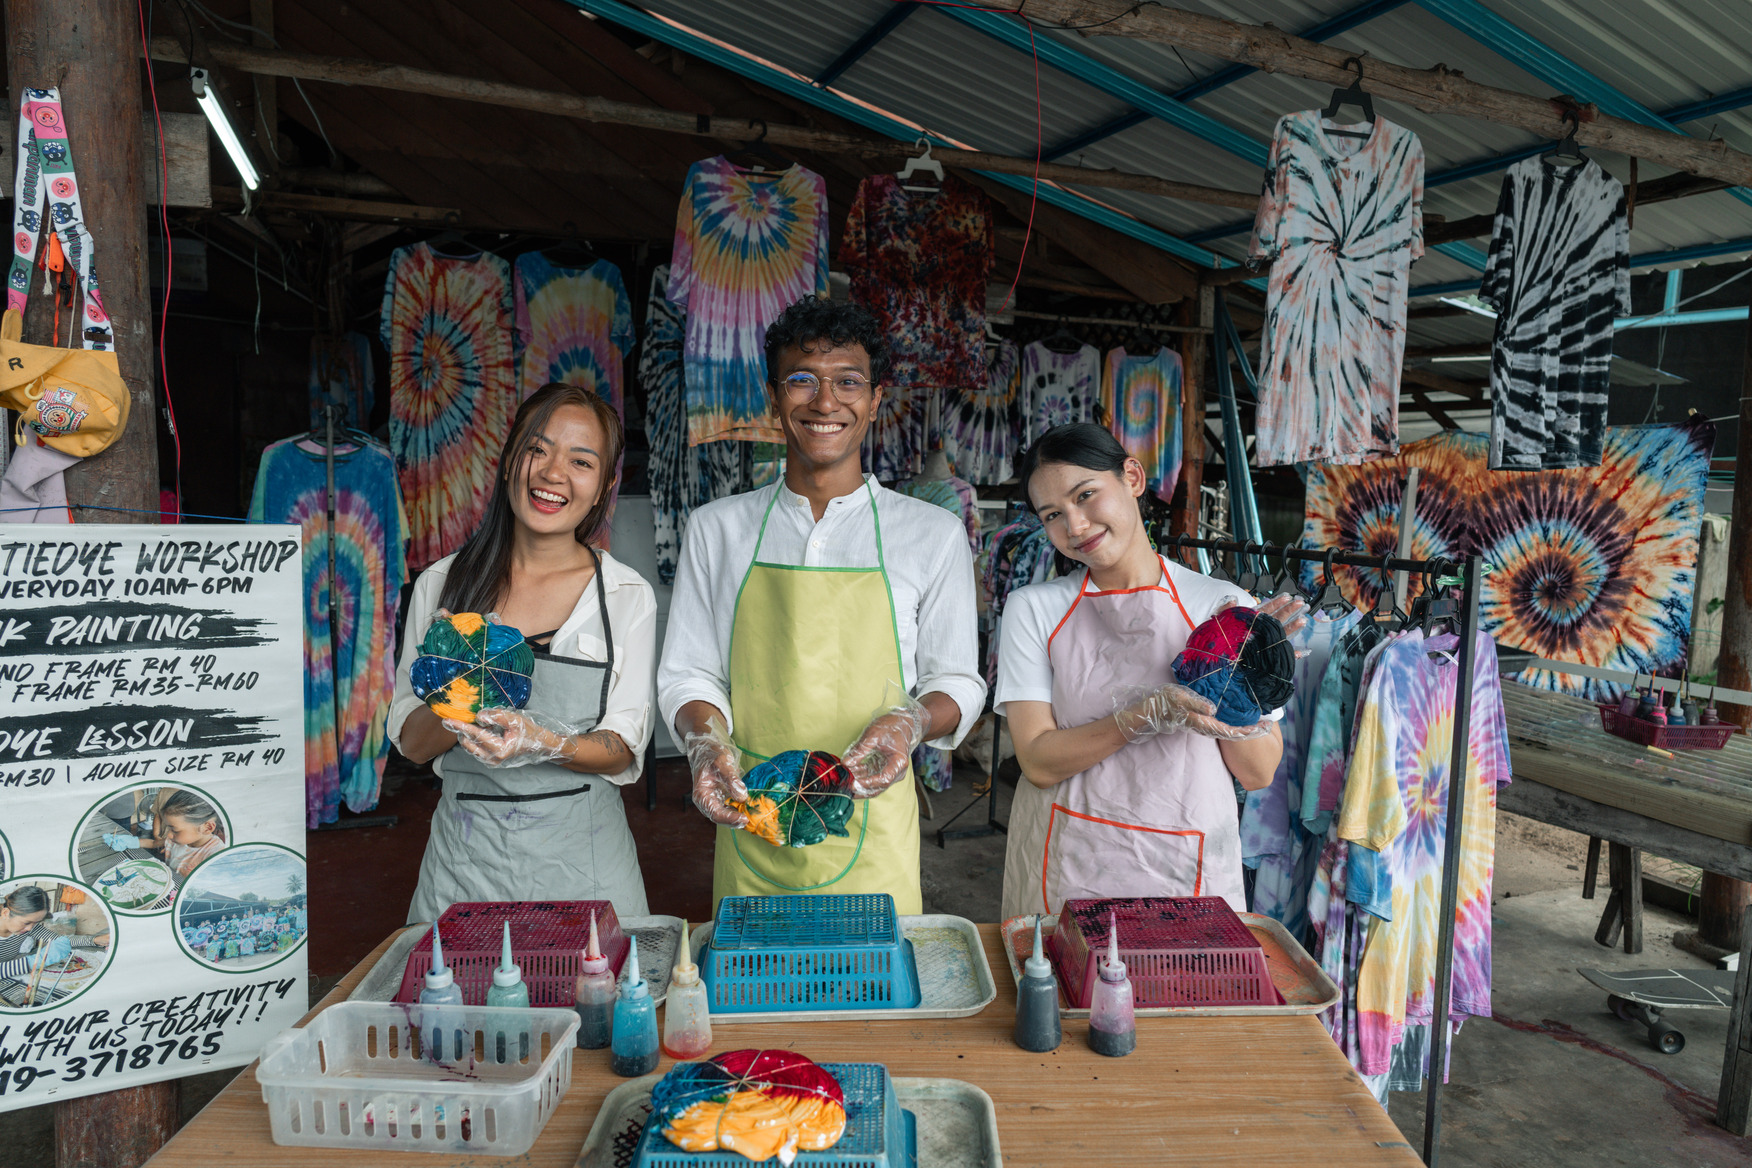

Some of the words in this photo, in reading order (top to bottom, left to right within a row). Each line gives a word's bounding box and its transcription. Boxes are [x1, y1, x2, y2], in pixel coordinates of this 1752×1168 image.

[1, 541, 122, 577] TIEDYE
[135, 540, 299, 574] WORKSHOP
[124, 576, 253, 597] 10AM-6PM
[45, 613, 203, 646] PAINTING
[44, 659, 131, 681] FRAME
[142, 657, 180, 675] RM
[190, 654, 216, 673] 40
[12, 681, 100, 703] FRAME
[110, 671, 260, 699] RM35-RM60
[76, 718, 194, 753] LESSON
[83, 760, 157, 782] ADULT
[165, 754, 213, 775] SIZE
[220, 750, 252, 768] RM
[262, 748, 285, 765] 40
[24, 1010, 110, 1043] YOUR
[122, 978, 296, 1026] CREATIVITY
[0, 1035, 76, 1068] WITH
[89, 1026, 127, 1049] US
